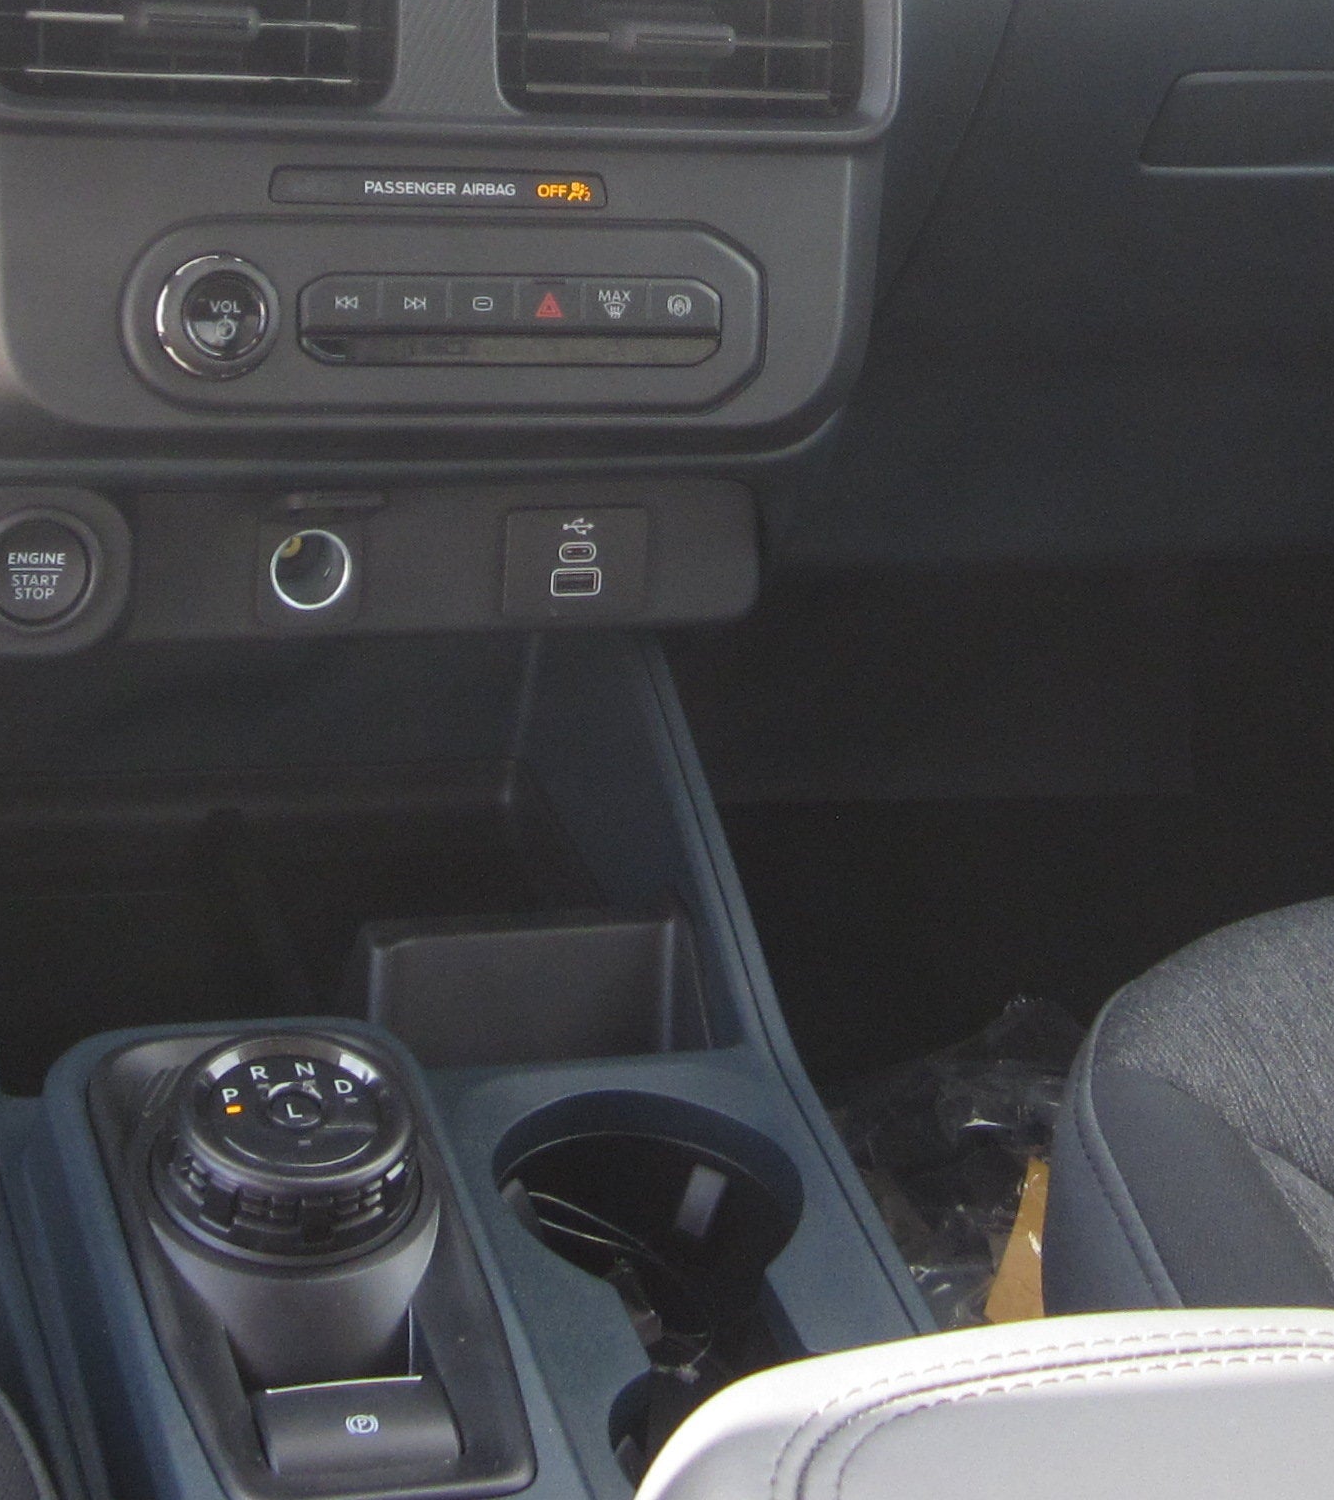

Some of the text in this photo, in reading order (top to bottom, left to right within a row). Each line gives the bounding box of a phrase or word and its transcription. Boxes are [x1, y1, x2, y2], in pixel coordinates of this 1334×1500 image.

[364, 180, 566, 199] PASSENGER AIRBAG OFF
[597, 289, 631, 304] MAX
[209, 299, 242, 314] VOL
[7, 552, 66, 565] ENGINE
[11, 574, 59, 587] START
[14, 587, 55, 600] STOP
[221, 1061, 353, 1104] P R N D
[286, 1102, 303, 1119] L
